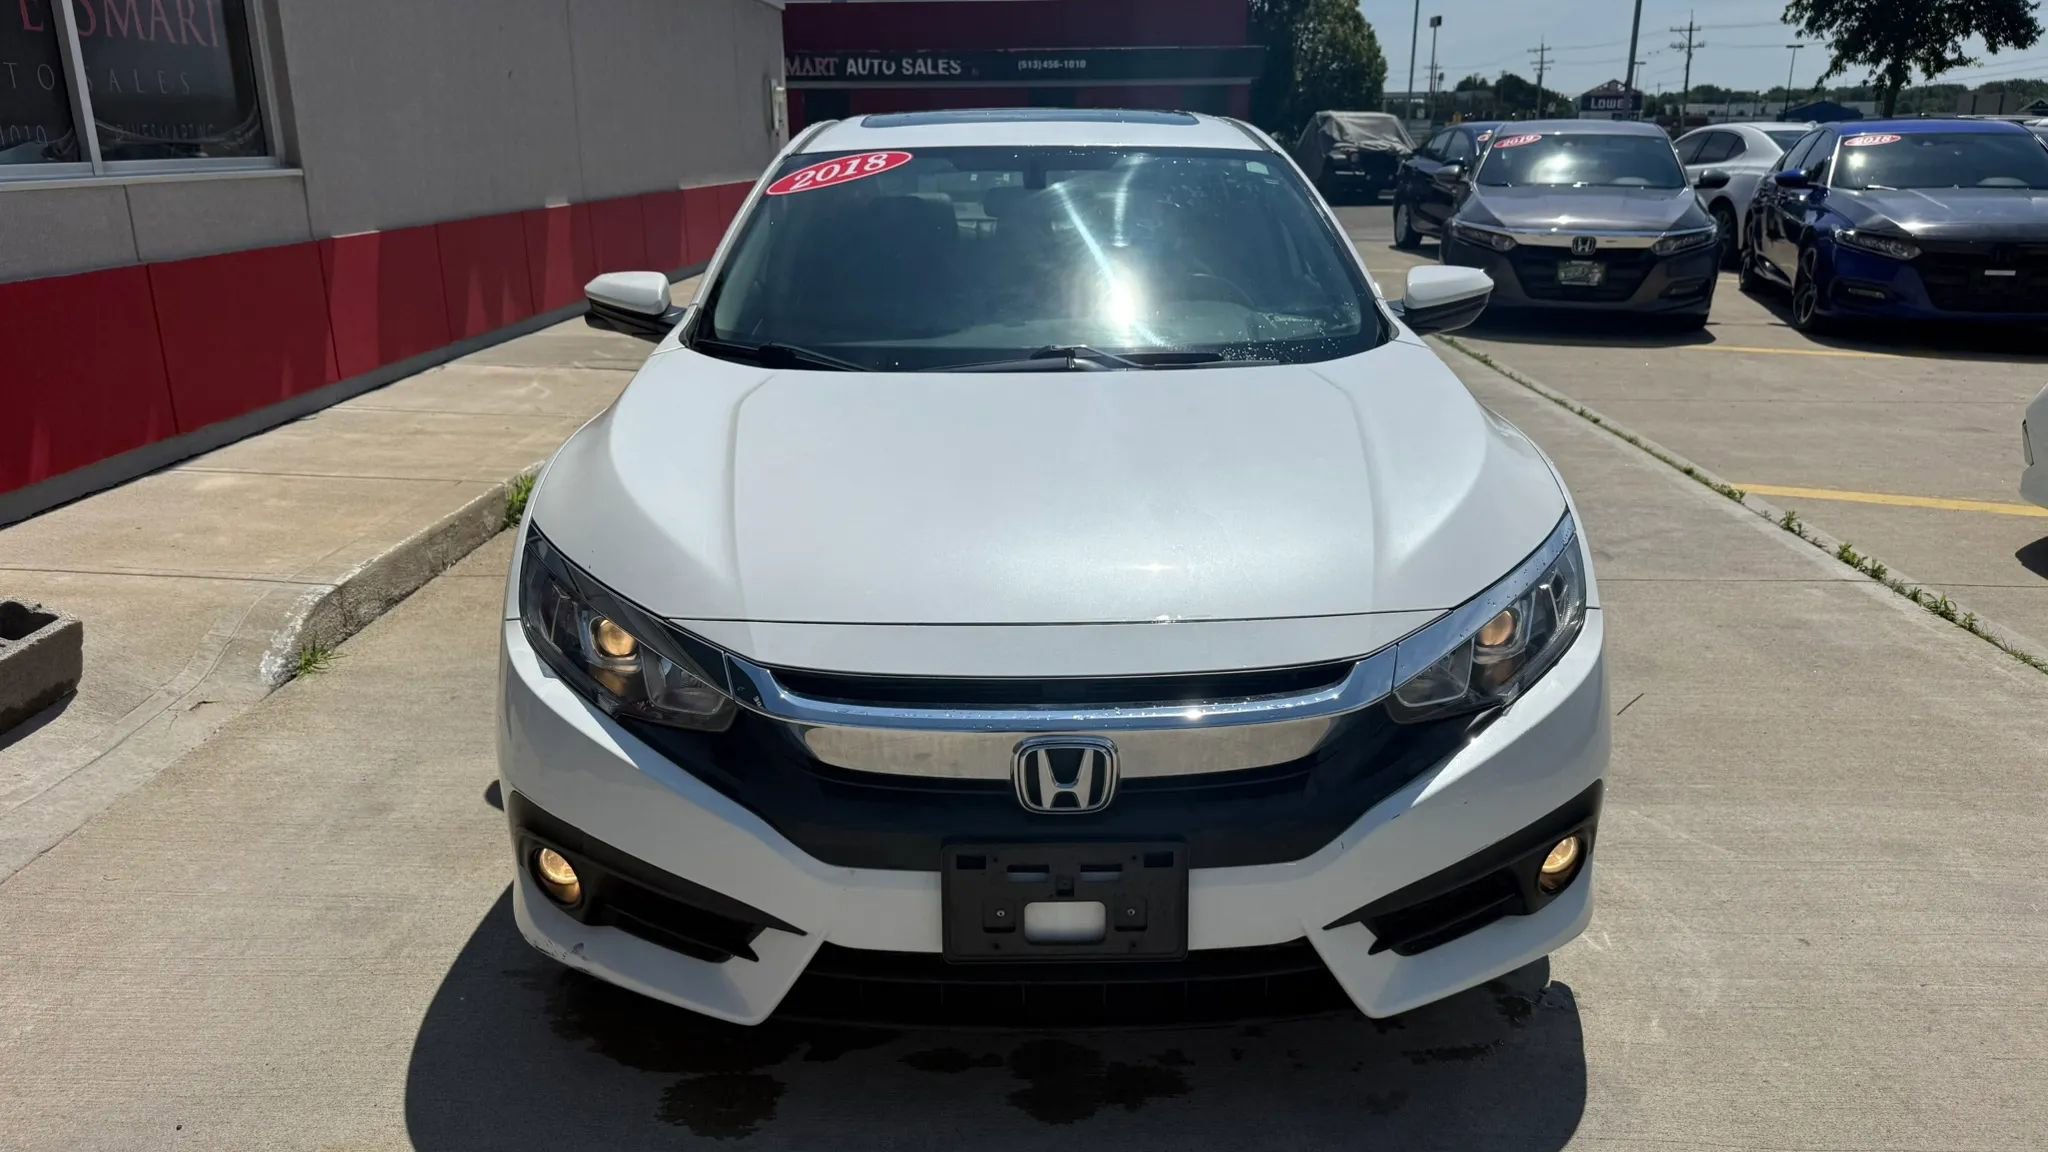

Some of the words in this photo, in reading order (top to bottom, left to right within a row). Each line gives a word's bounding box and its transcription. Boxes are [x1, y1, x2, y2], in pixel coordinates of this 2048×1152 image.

[846, 57, 896, 76] AUTO
[902, 57, 961, 76] SALES
[789, 153, 889, 191] 2018
